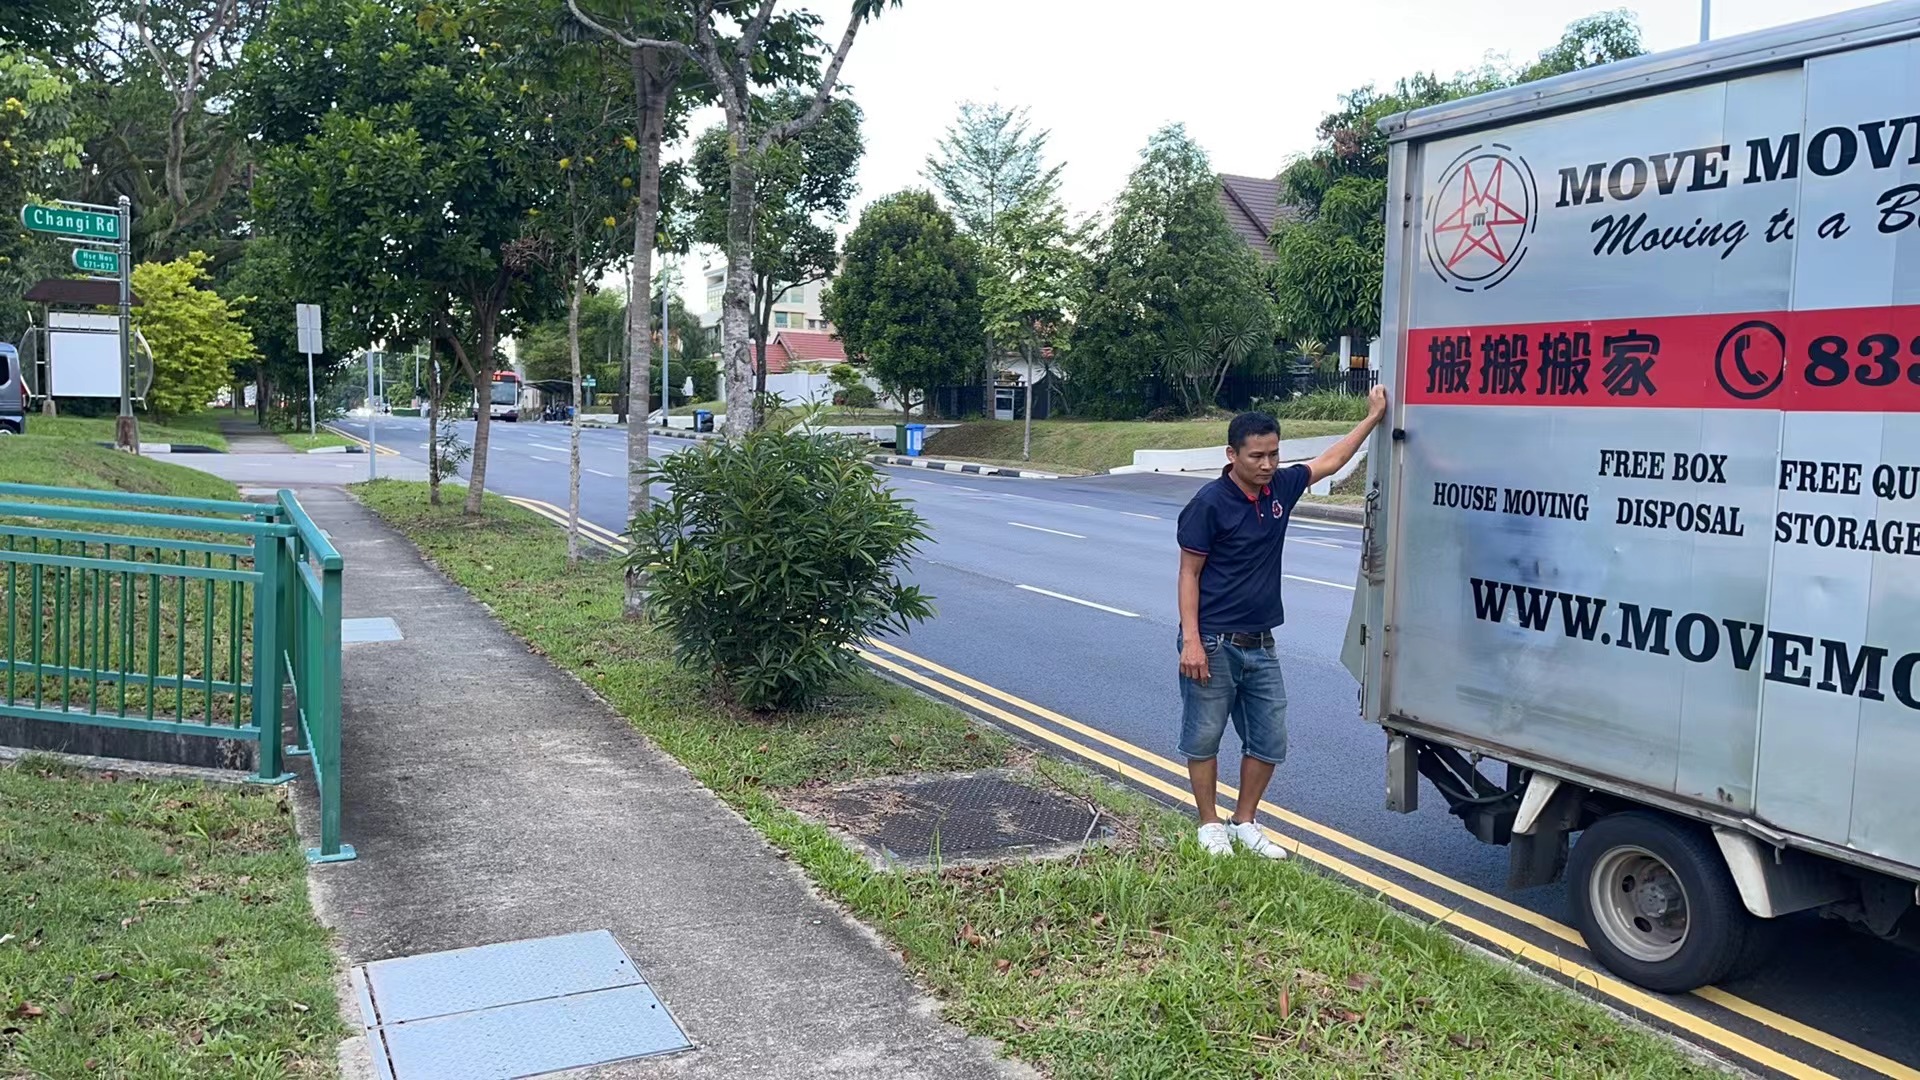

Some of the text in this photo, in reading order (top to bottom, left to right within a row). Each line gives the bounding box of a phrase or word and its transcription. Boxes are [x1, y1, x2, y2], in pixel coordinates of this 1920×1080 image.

[1555, 114, 1920, 208] MOVE MOV
[33, 209, 114, 233] Changi Rd
[1590, 212, 1749, 260] Moving
[1817, 212, 1851, 239] a
[1876, 183, 1920, 234] B
[83, 252, 96, 260] Hse
[1426, 329, 1660, 396] 搬搬搬家
[1598, 449, 1728, 483] FREE BOX
[1778, 460, 1920, 500] FREE QU
[1432, 482, 1589, 521] HOUSE MOVING
[1616, 497, 1744, 537] DISPOSAL
[1775, 511, 1920, 556] STORAGE
